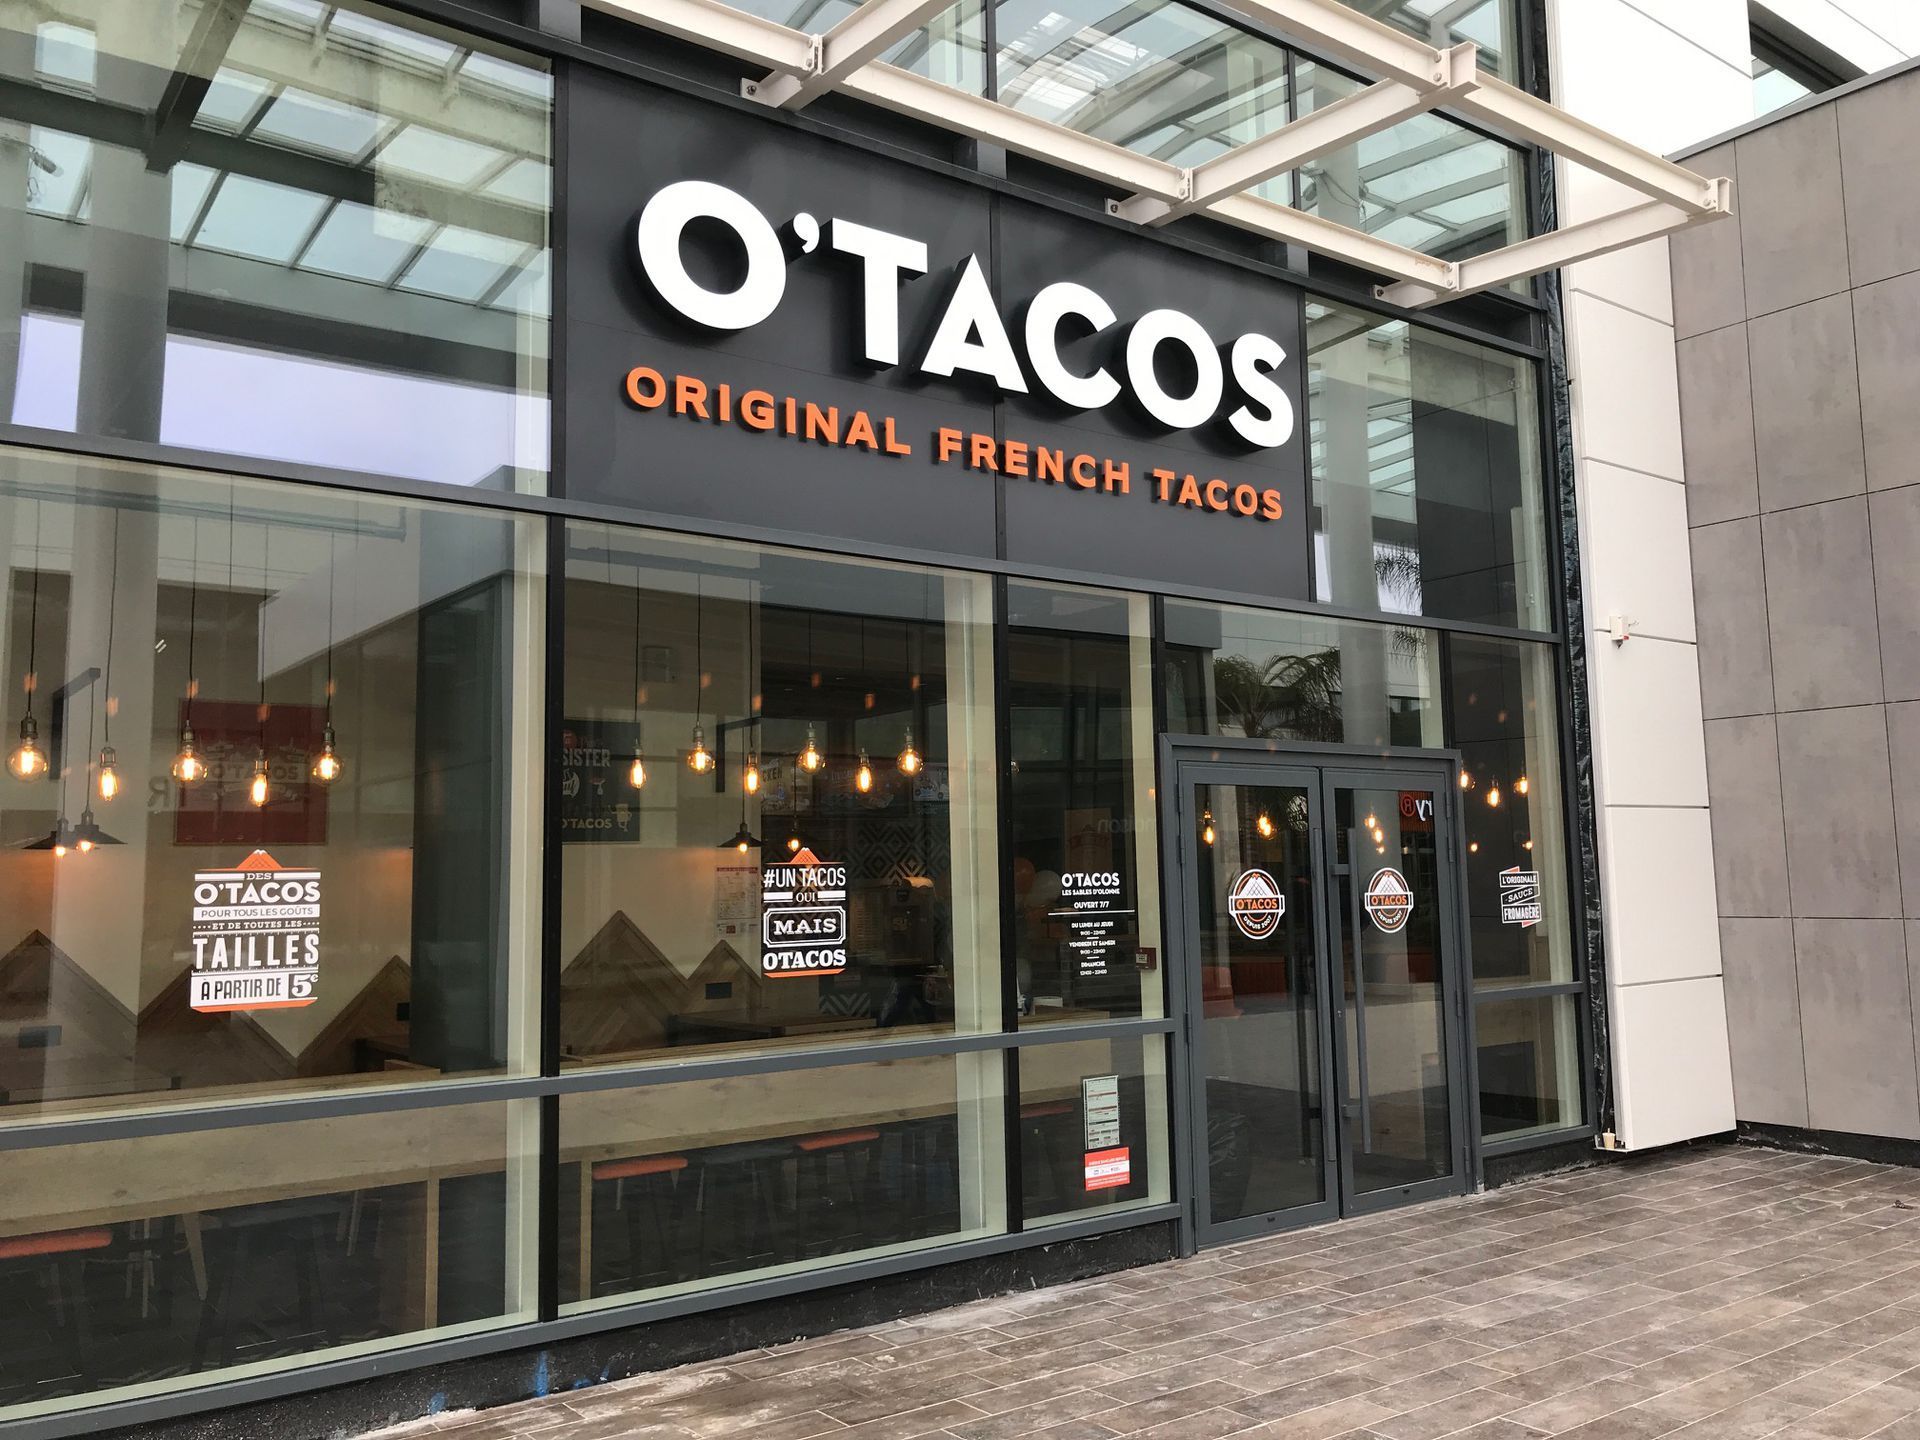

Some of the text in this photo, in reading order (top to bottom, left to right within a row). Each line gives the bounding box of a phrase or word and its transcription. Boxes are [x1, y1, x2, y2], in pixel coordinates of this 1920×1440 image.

[637, 180, 1294, 448] O'TACOS
[626, 367, 1283, 521] ORIGINAL FRENCH TACOS
[247, 872, 272, 880] DES
[763, 868, 796, 888] #UN
[798, 867, 846, 887] TACOS
[1061, 872, 1120, 888] O'TACOS
[194, 881, 321, 905] O'TACOS
[796, 892, 816, 903] OUI
[1371, 895, 1408, 906] O'TACOS
[1508, 888, 1533, 903] SAUCE
[1074, 901, 1099, 909] OUVERT
[1236, 898, 1278, 910] O'TACOS
[201, 906, 313, 918] POUR TOUS LES GOÛTS
[212, 920, 302, 930] ET DE TOUTES LES
[774, 918, 837, 935] MAIS
[193, 934, 320, 969] TAILLES
[214, 979, 262, 1000] PARTIR
[266, 977, 281, 996] DE
